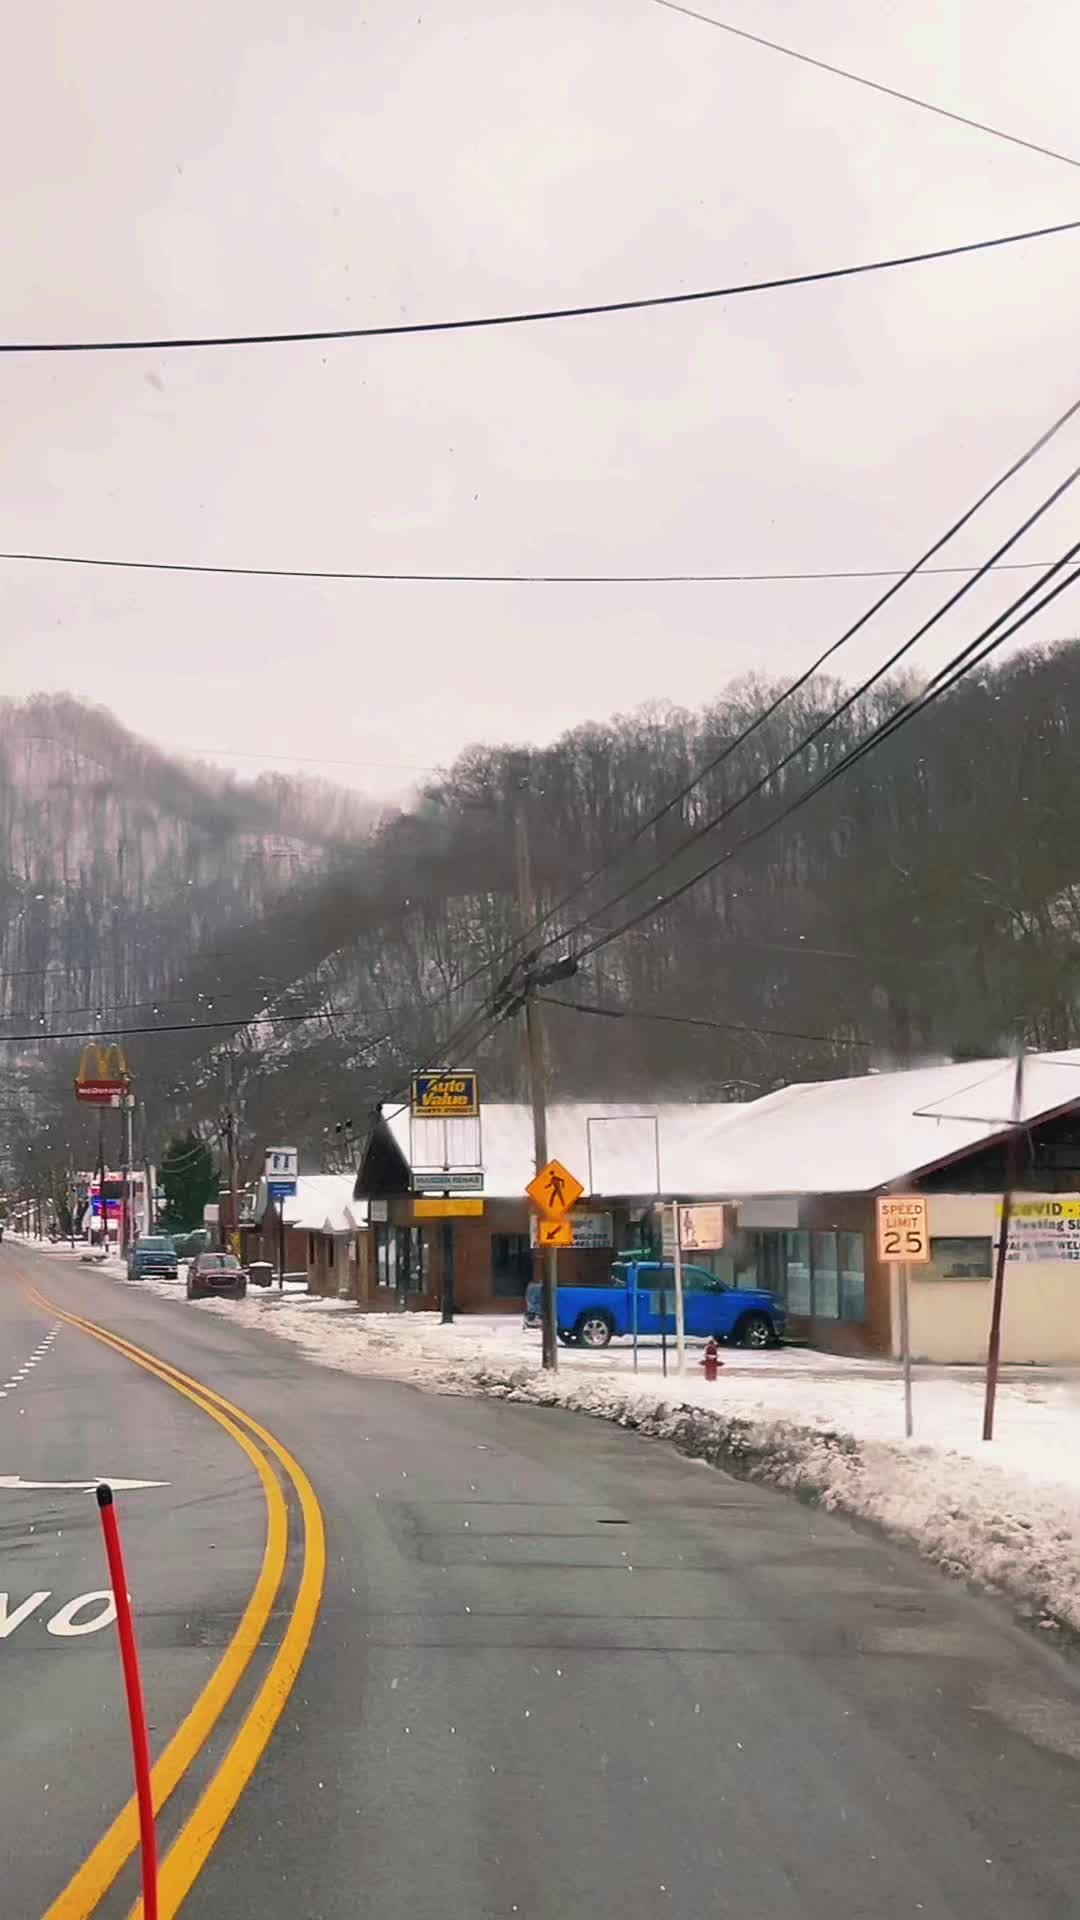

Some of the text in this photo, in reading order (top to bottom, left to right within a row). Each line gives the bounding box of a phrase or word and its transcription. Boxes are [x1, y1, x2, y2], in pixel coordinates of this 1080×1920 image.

[426, 1079, 466, 1093] Auto
[422, 1092, 468, 1106] Value
[882, 1204, 922, 1215] SPEED
[886, 1217, 918, 1228] LIMIT
[884, 1231, 922, 1254] 25
[1056, 1241, 1080, 1250] WEL
